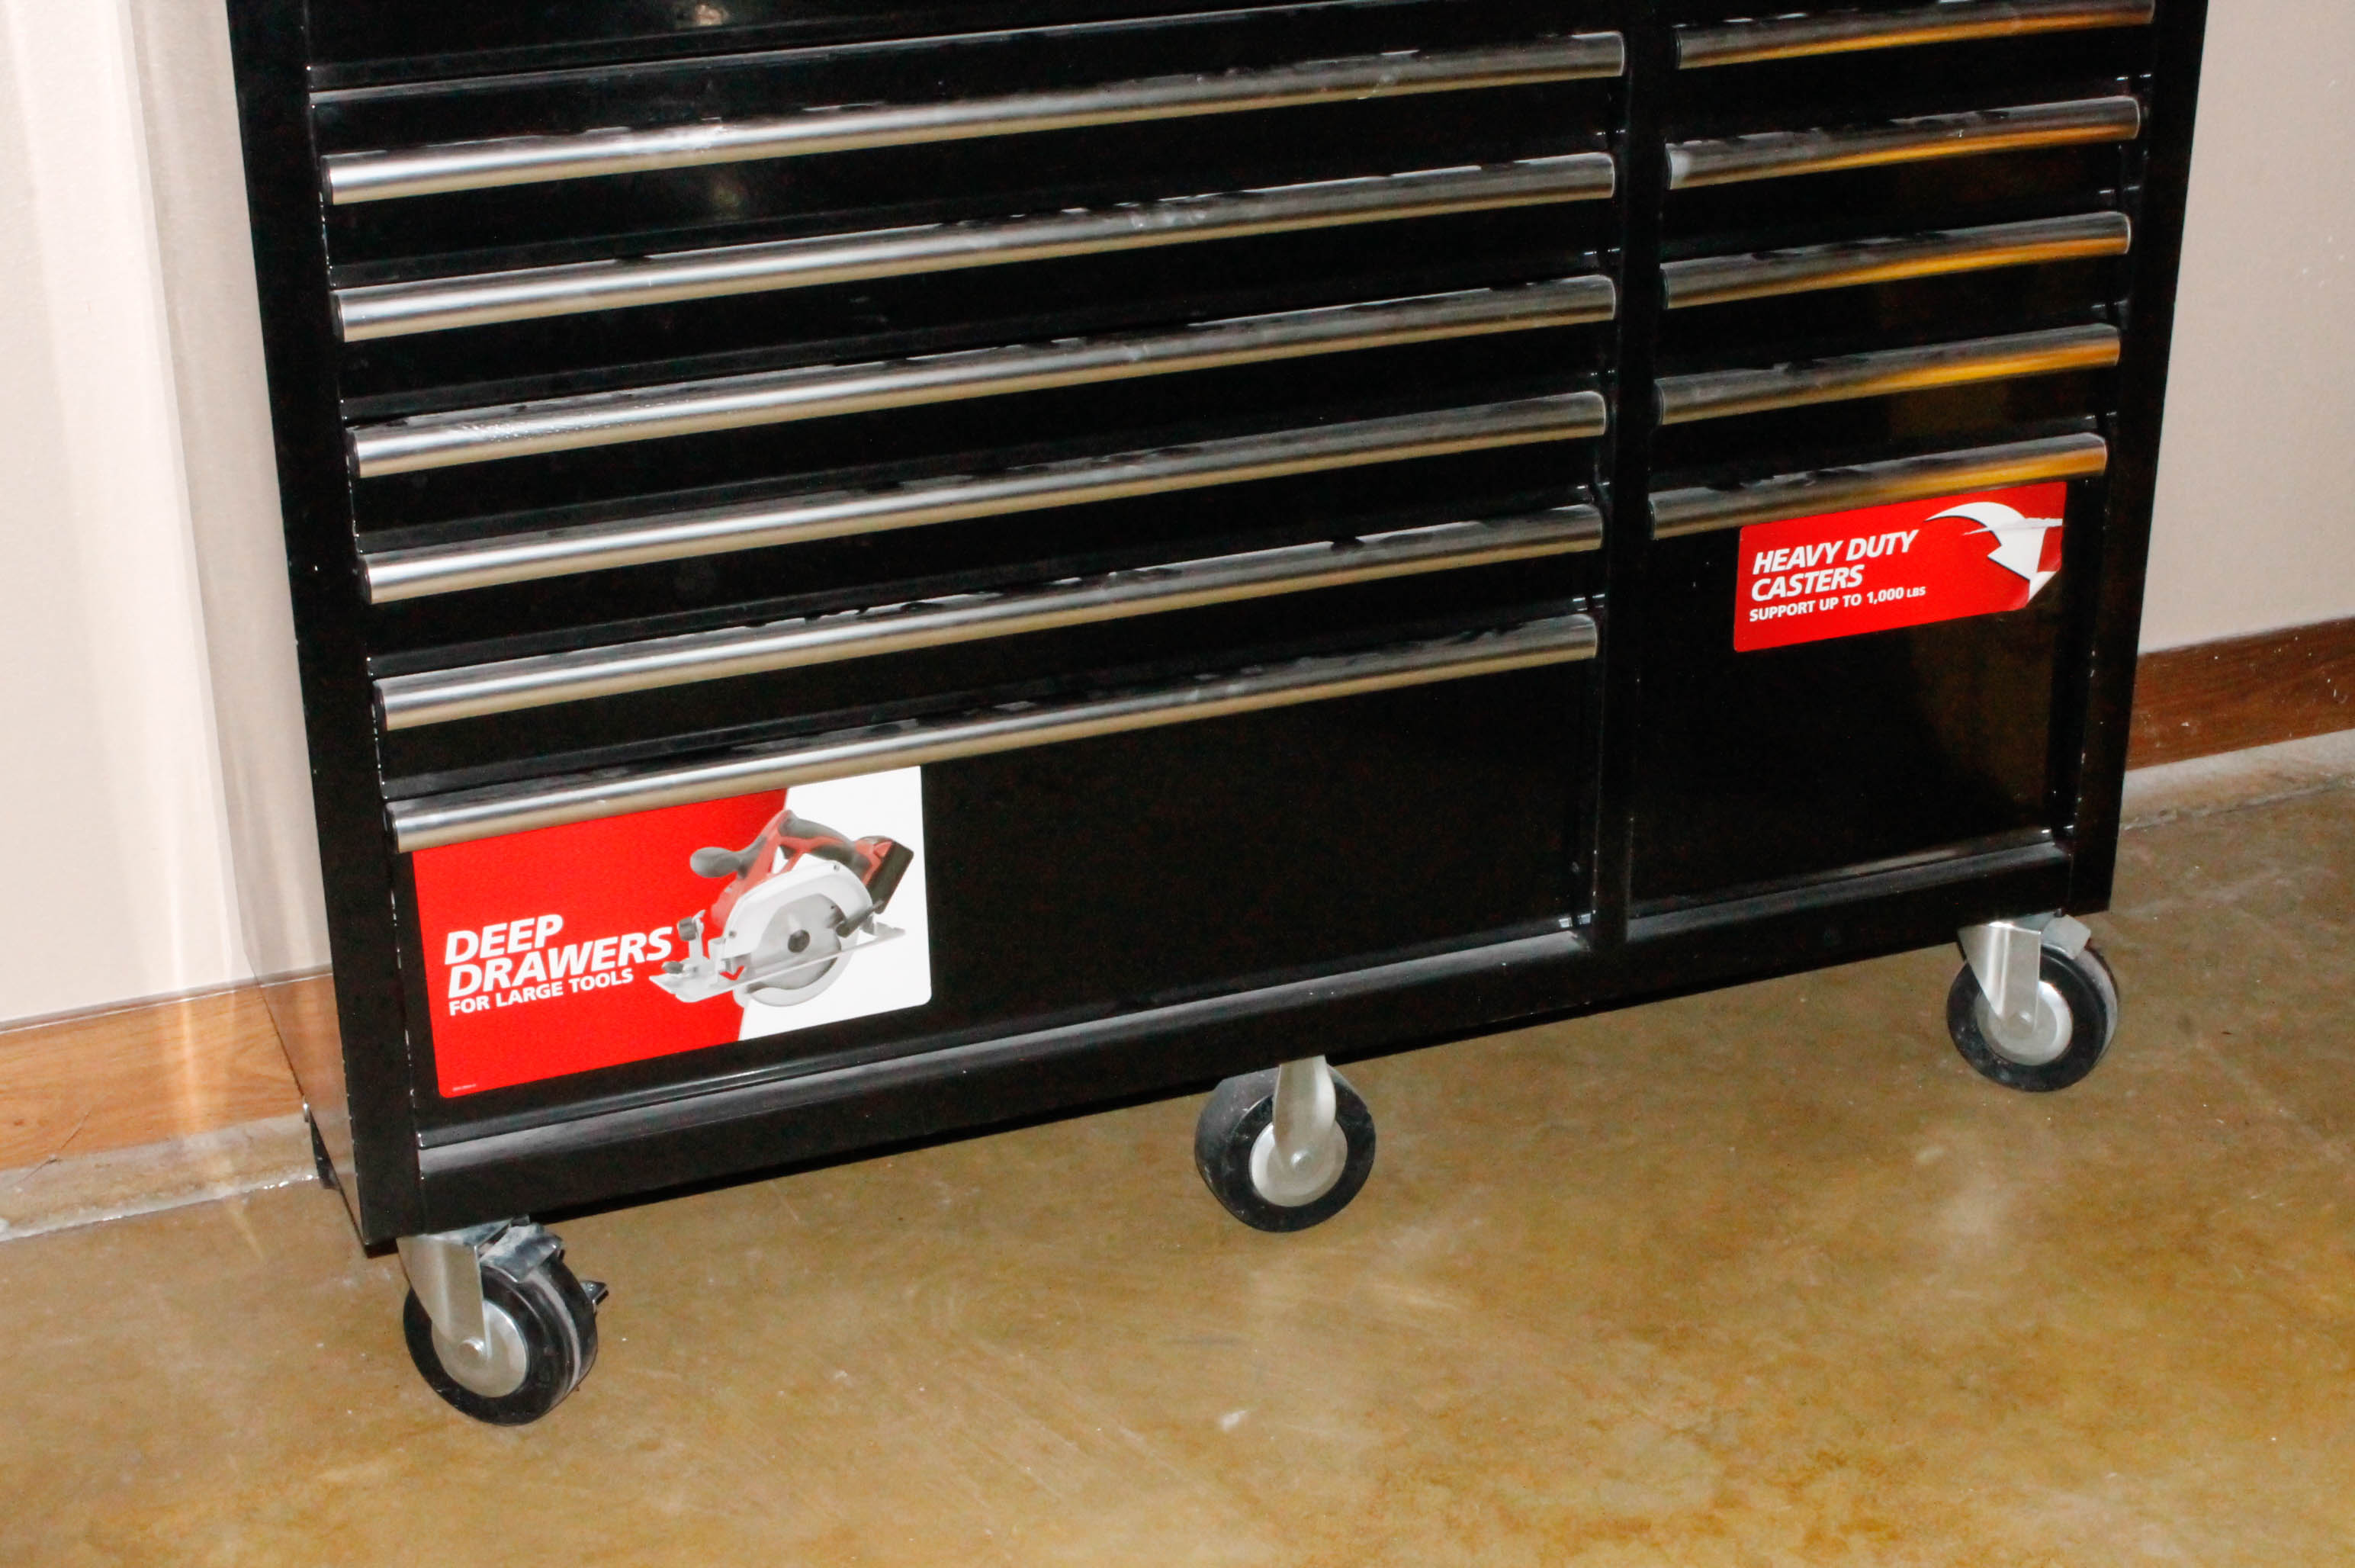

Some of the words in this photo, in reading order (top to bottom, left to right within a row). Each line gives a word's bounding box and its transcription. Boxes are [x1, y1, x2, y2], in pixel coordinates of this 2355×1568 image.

[1752, 540, 1844, 575] HEAVY
[1846, 529, 1920, 561] DUTY
[1749, 599, 1816, 622] SUPPORT
[1819, 597, 1839, 612] UP
[1843, 593, 1862, 608] TO
[1866, 586, 1904, 605] 1,000
[1907, 586, 1926, 598] LBS
[1751, 564, 1865, 602] CASTERS
[444, 914, 564, 965] DEEP
[447, 927, 673, 999] DRAWERS
[448, 994, 490, 1017] FOR
[495, 980, 564, 1007] LARGE
[567, 967, 635, 994] TOOLS
